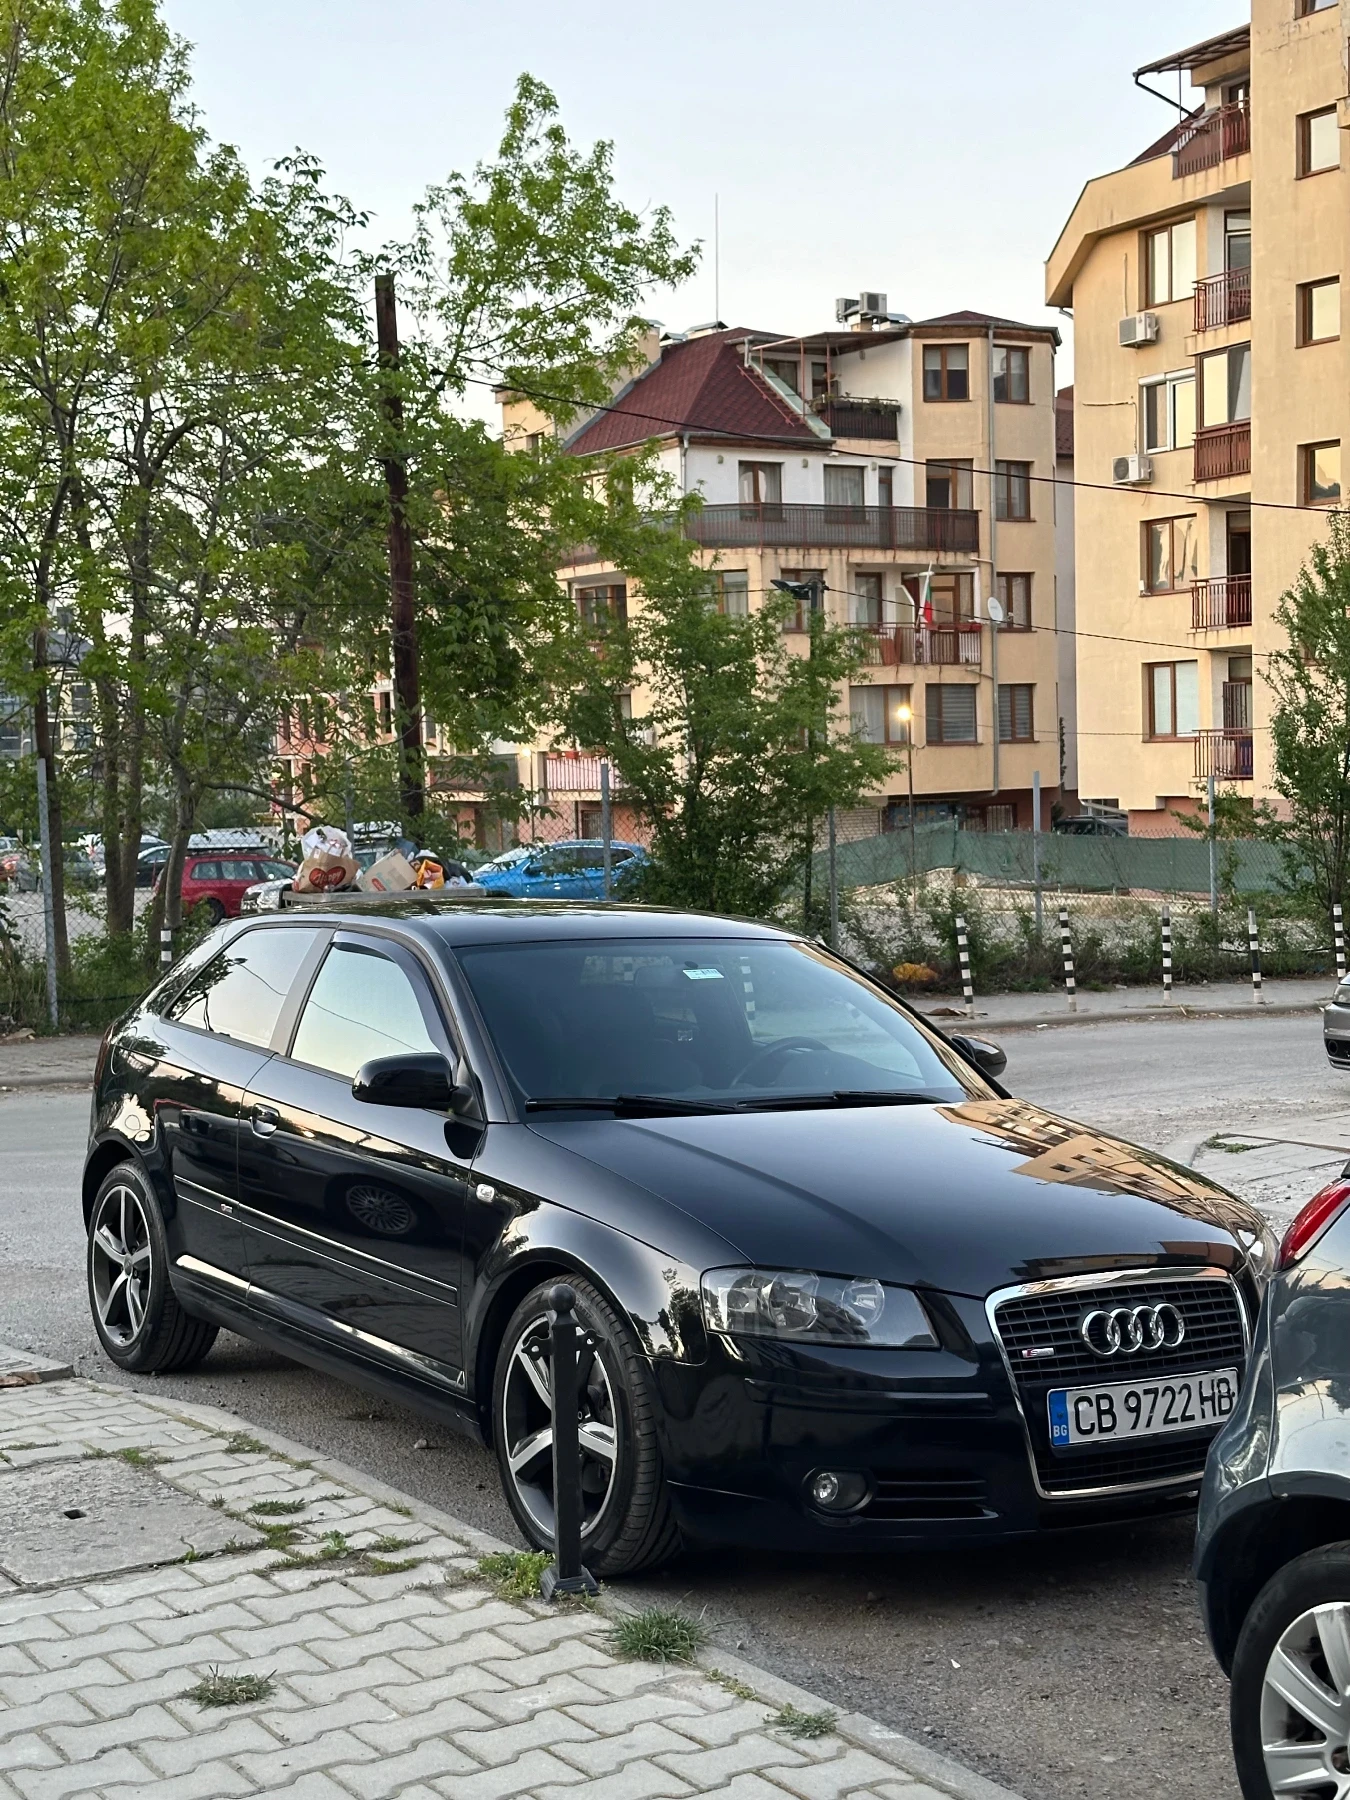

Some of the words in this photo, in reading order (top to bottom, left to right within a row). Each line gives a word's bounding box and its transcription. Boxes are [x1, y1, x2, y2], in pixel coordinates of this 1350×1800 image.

[1073, 1393, 1117, 1436] CB
[1124, 1383, 1195, 1430] 9722
[1198, 1377, 1234, 1419] HB
[1053, 1425, 1068, 1437] BG
